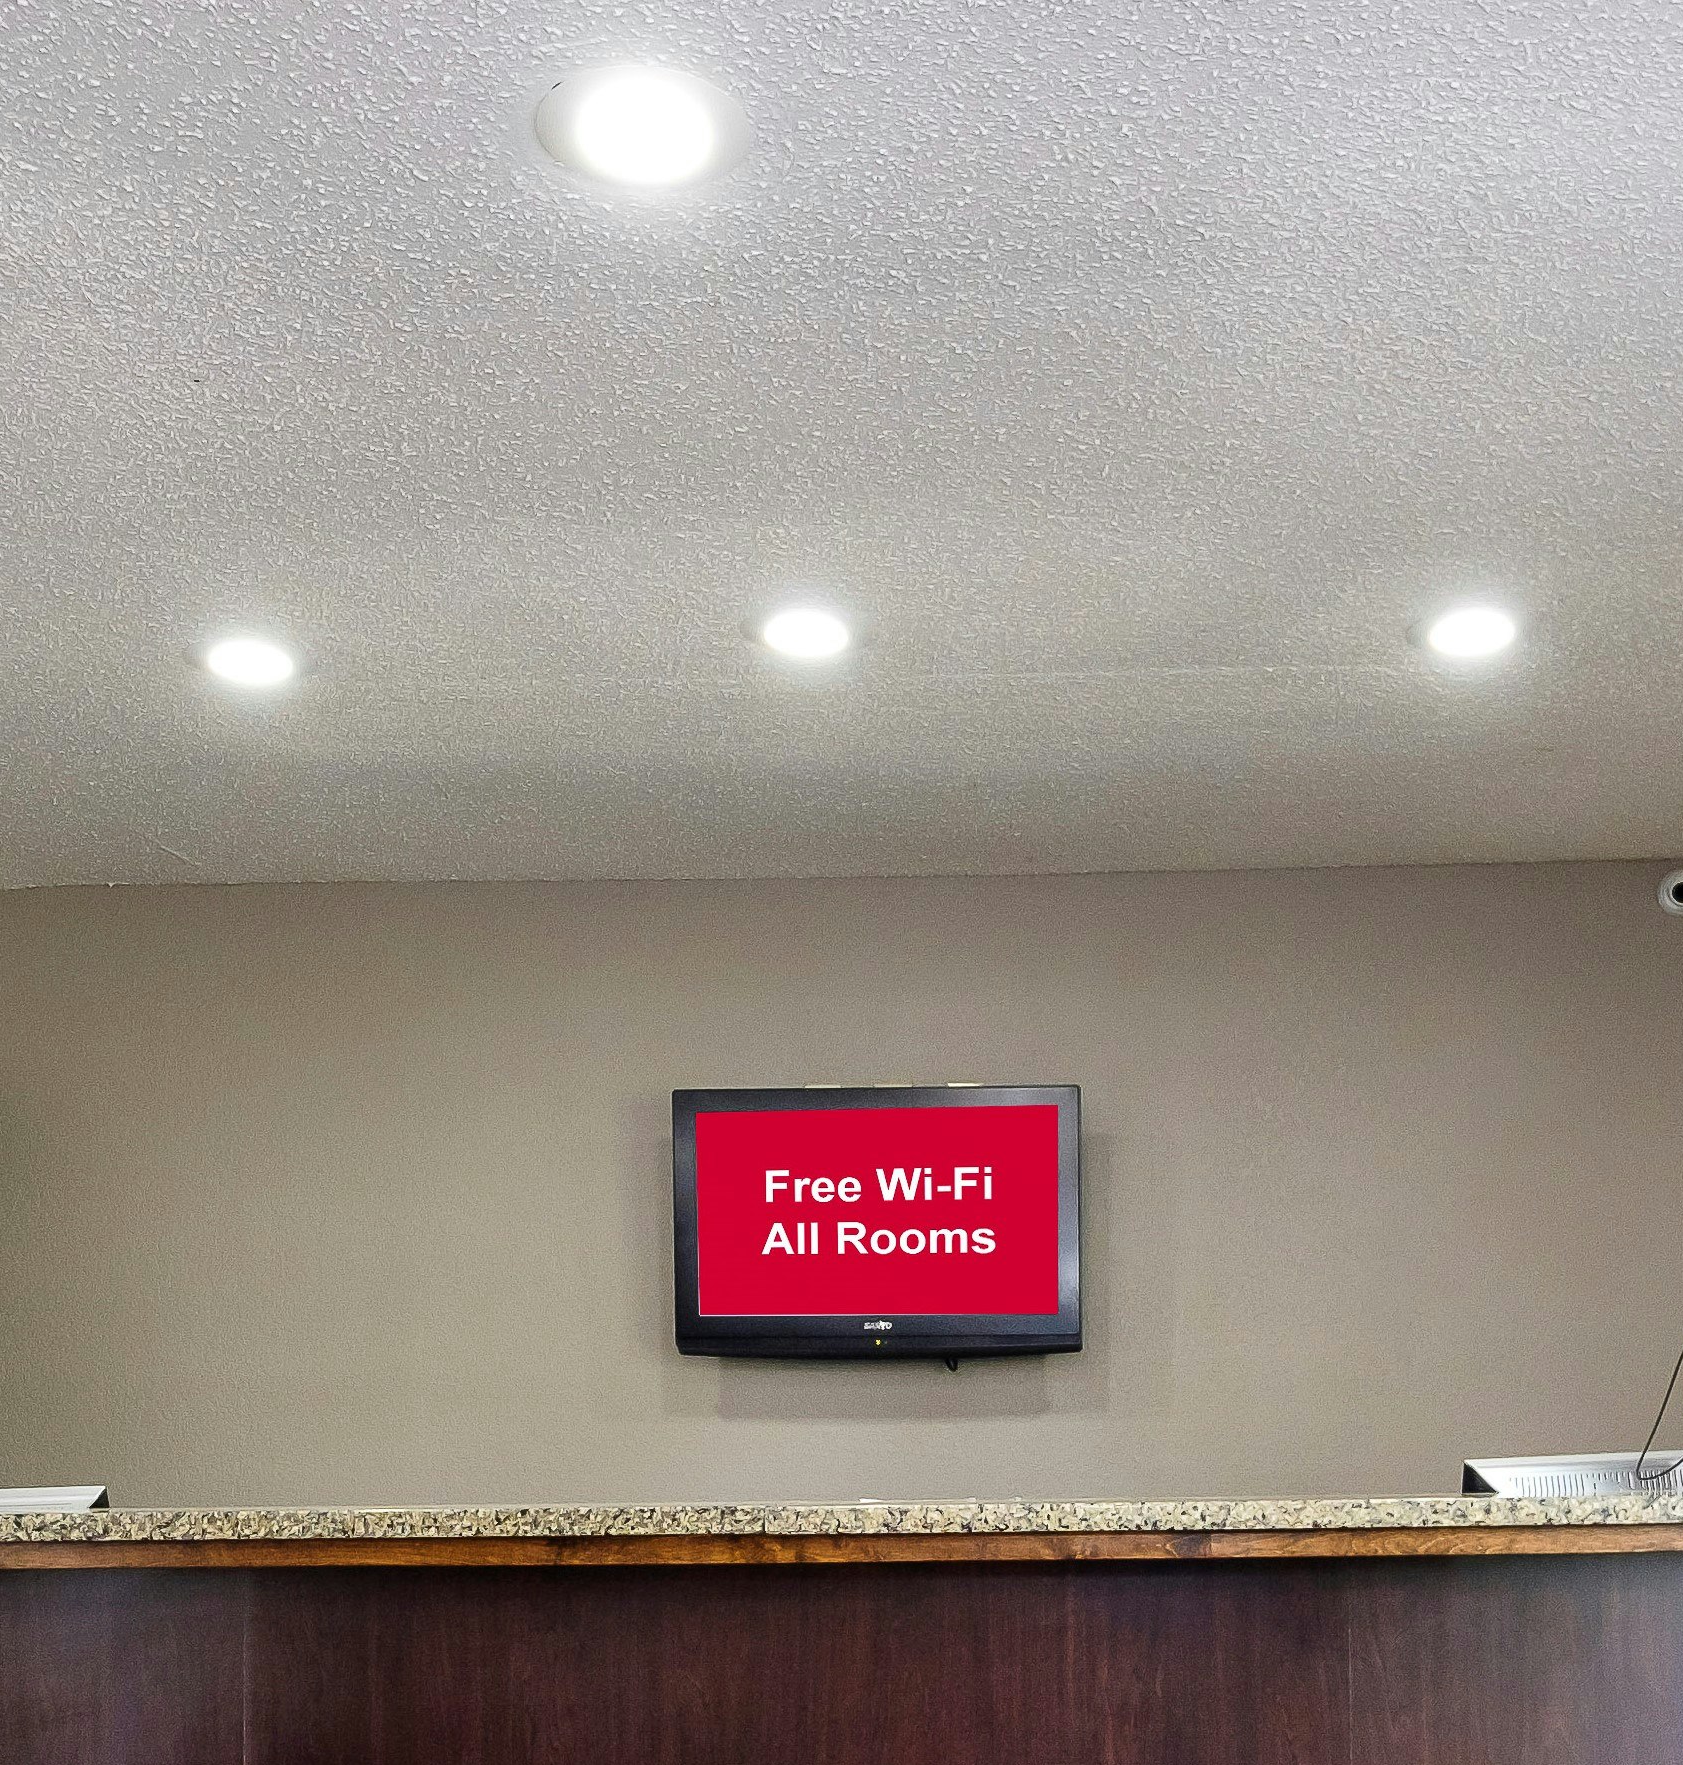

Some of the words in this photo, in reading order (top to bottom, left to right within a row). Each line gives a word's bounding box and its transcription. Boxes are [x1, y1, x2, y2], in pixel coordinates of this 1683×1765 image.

[765, 1169, 862, 1203] Free
[875, 1166, 992, 1202] Wi-Fi
[761, 1221, 819, 1255] All
[837, 1221, 996, 1255] Rooms
